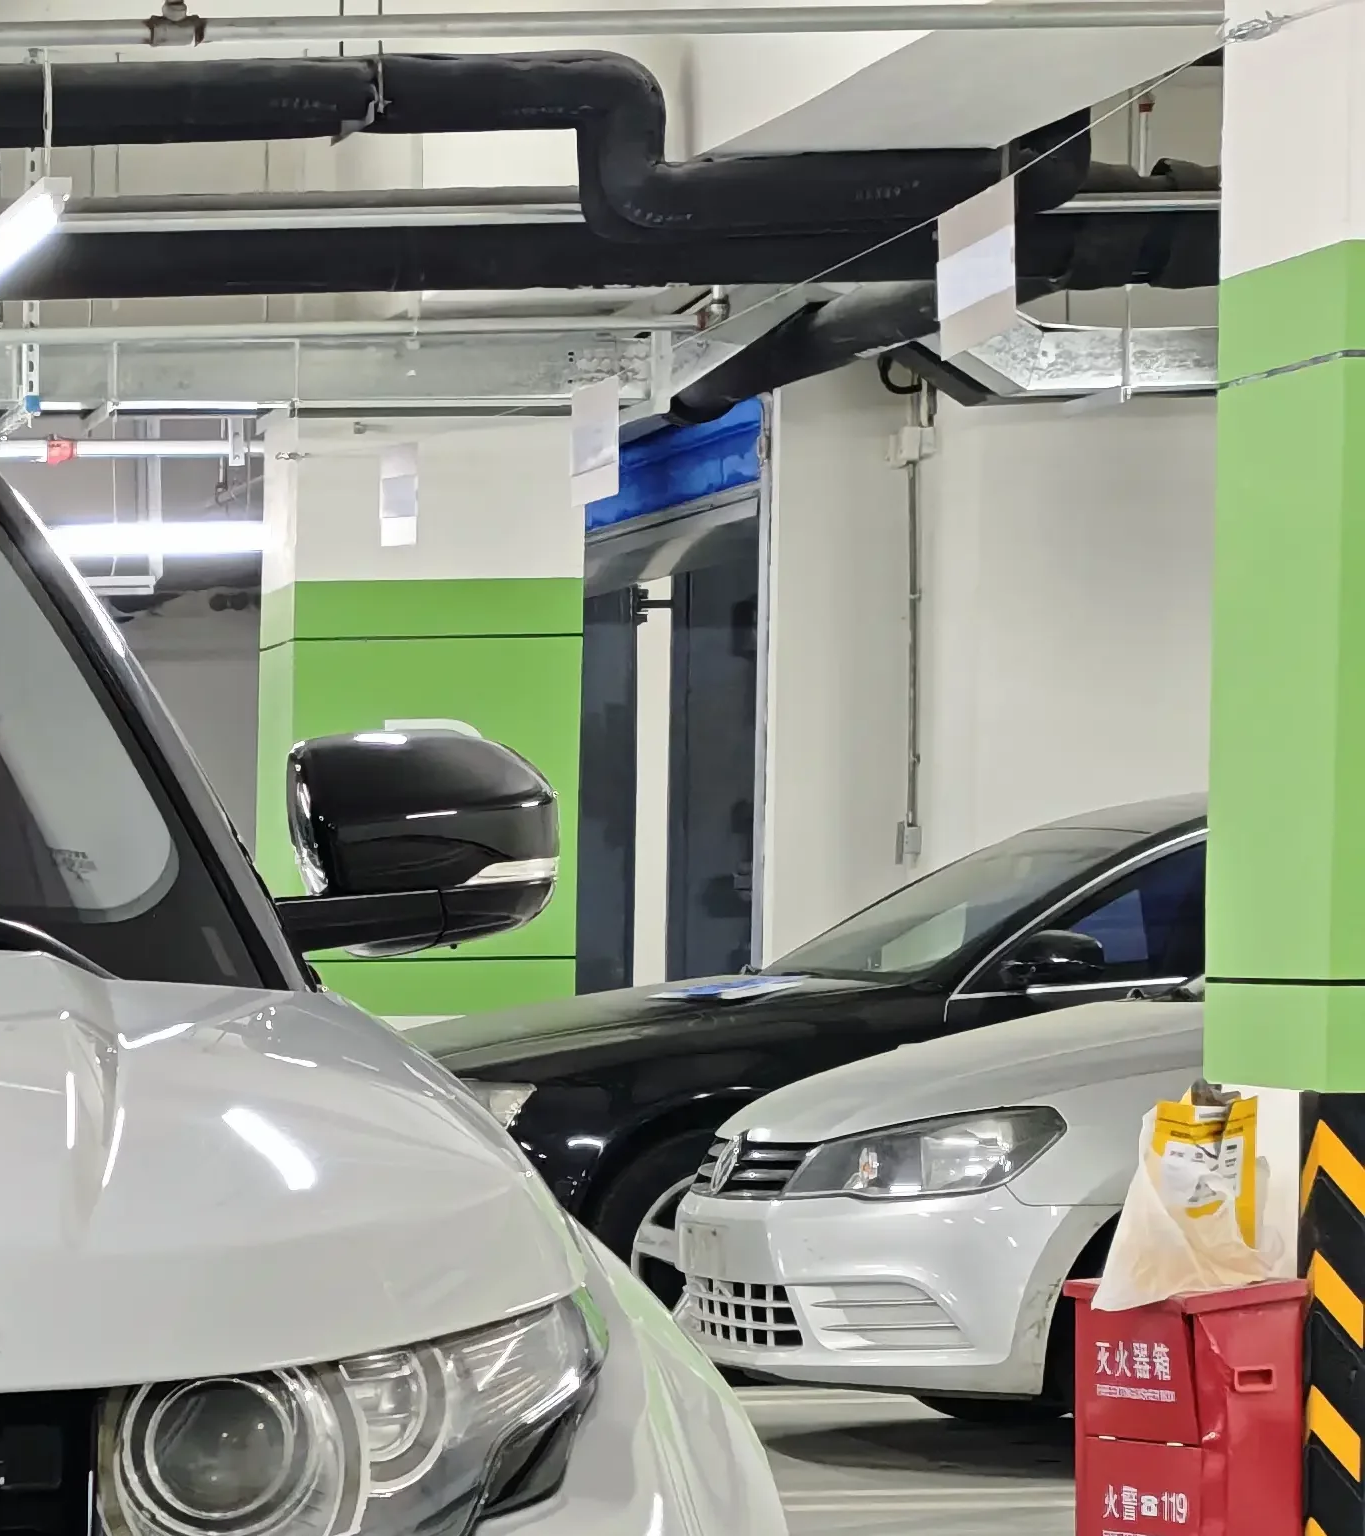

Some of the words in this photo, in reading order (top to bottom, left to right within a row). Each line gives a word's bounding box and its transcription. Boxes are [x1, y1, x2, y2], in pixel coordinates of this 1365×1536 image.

[1095, 1340, 1172, 1381] 灭火器箱
[1101, 1484, 1138, 1521] 火警
[1160, 1491, 1188, 1523] 119
